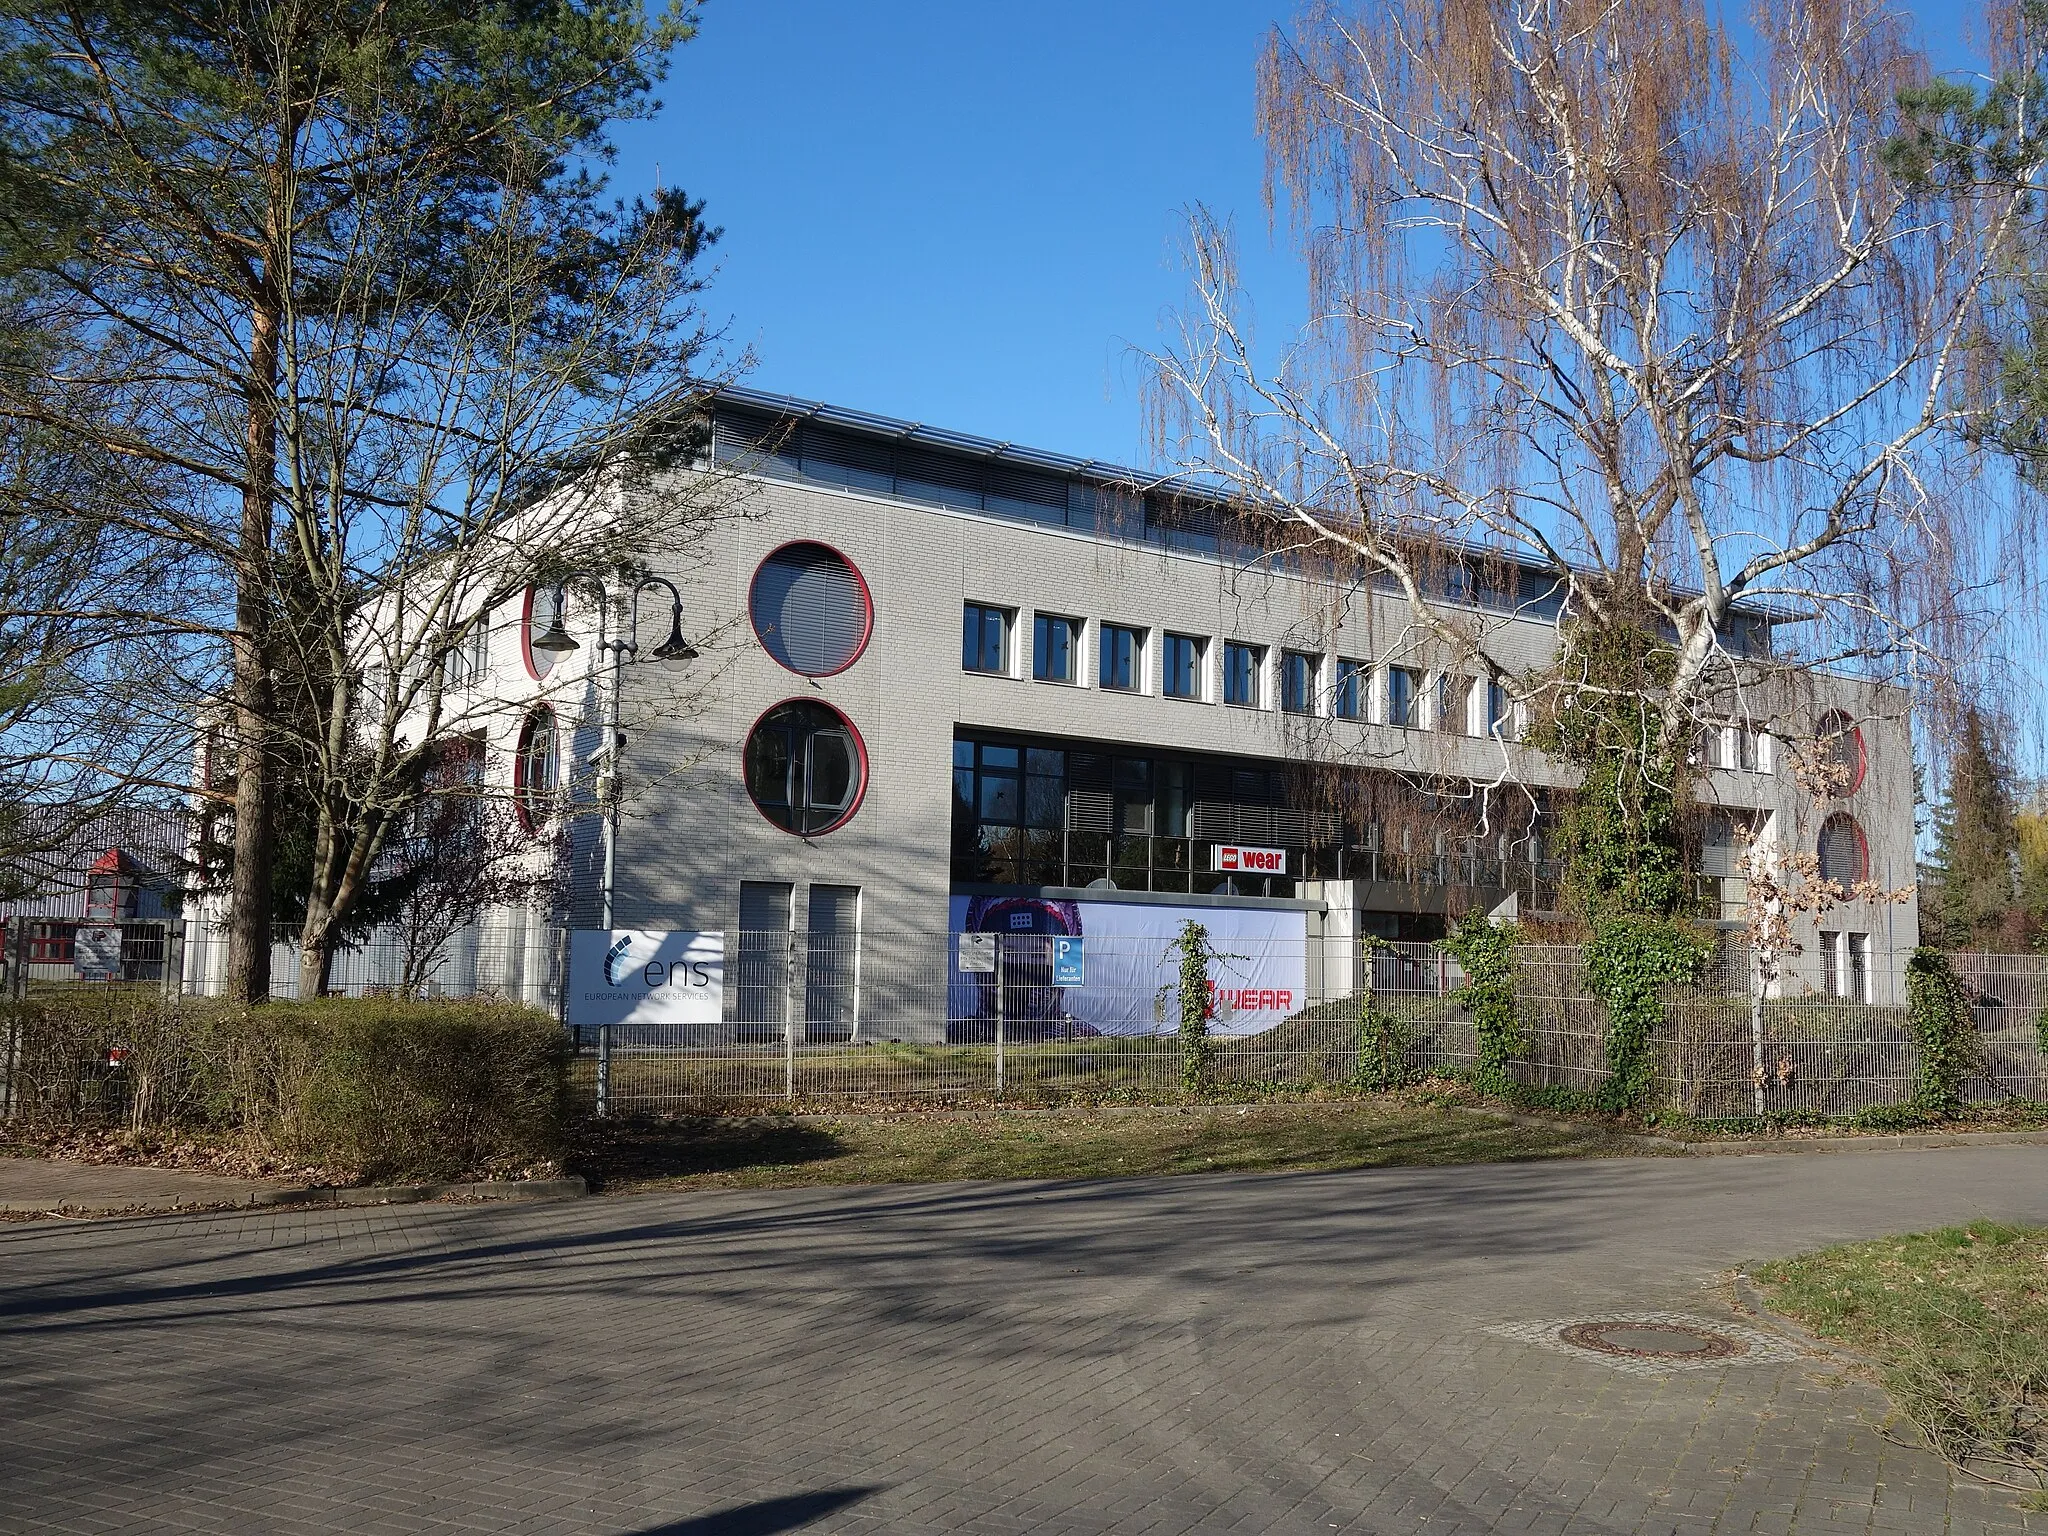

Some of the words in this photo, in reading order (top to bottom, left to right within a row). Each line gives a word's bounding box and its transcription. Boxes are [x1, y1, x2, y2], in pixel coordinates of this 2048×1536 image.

[1223, 853, 1237, 862] LEGO
[1243, 851, 1282, 870] wear
[1059, 940, 1071, 960] P
[644, 960, 709, 987] ens
[584, 992, 629, 1001] EUROPEAN
[630, 992, 671, 1001] NETWORK
[672, 992, 709, 1001] SERVICES
